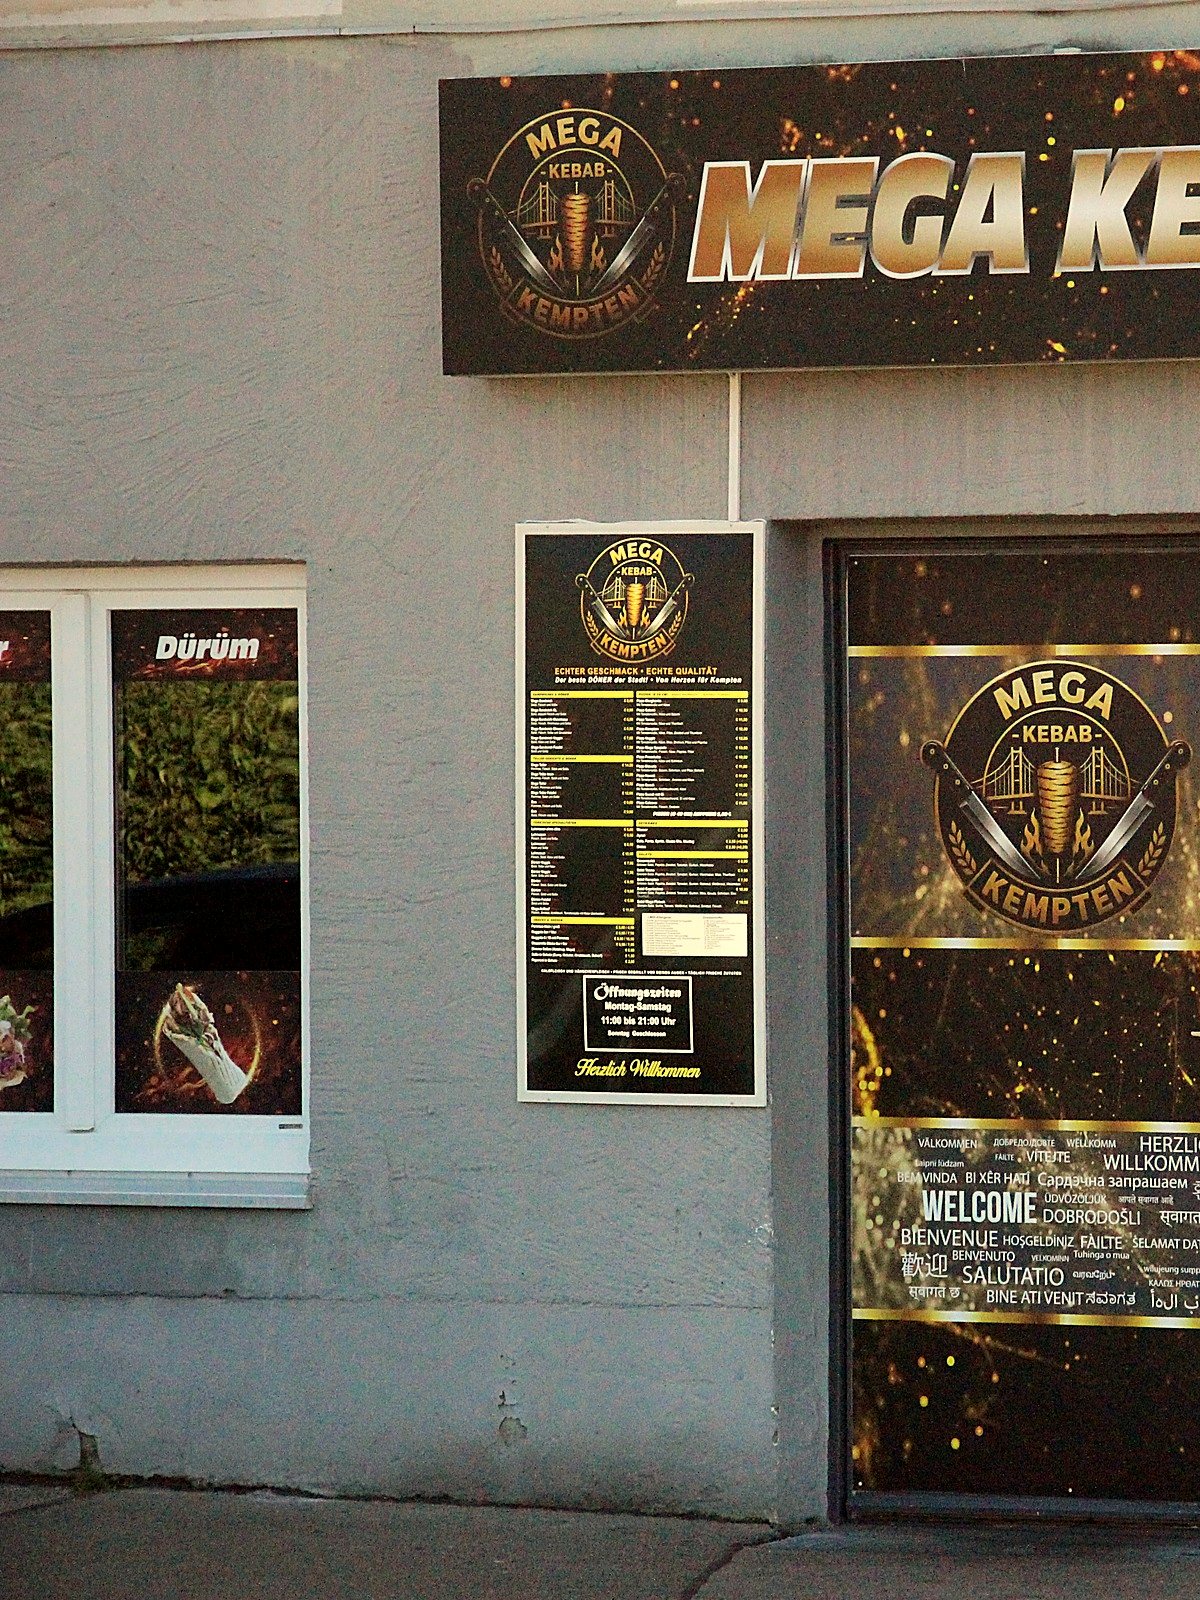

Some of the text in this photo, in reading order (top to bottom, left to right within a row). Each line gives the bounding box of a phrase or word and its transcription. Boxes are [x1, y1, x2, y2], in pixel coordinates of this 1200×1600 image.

[525, 116, 623, 159] MEGA
[686, 151, 1031, 283] MEGA
[516, 284, 640, 328] KEMPTEN
[609, 541, 664, 565] MEGA
[155, 633, 260, 660] Dürüm
[600, 633, 668, 658] KEMPTEN
[554, 665, 718, 675] ECHTER GESCHMACK ECHTE QUALITÄT
[554, 676, 567, 684] Der
[568, 676, 587, 684] beste
[588, 675, 612, 684] DÖNER
[614, 676, 626, 684] der
[627, 676, 649, 684] Stadt!
[697, 677, 709, 685] für
[710, 677, 743, 686] Kempten
[993, 670, 1114, 720] MEGA
[981, 872, 1135, 925] KEMPTEN
[594, 983, 682, 1001] Öffnungszeiten
[604, 1002, 672, 1013] Montag-Samstag
[600, 1016, 677, 1026] 11:00 bis 21:00 Uhr
[575, 1058, 702, 1078] Herzlich Willkommen
[917, 1137, 978, 1149] VÄLKOMMEN
[922, 1172, 958, 1184] VINDA
[965, 1172, 976, 1184] BI
[1108, 1177, 1188, 1191] запрашаем
[922, 1190, 1037, 1224] WELCOME
[1043, 1207, 1141, 1226] DOBRODOŠLI
[901, 1228, 999, 1248] BIENVENUE
[1132, 1236, 1181, 1250] SELAMAT
[952, 1250, 1016, 1262] BENVENUTO
[962, 1266, 1065, 1287] SALUTATIO
[986, 1290, 1085, 1306] BINE ATI VENIT
